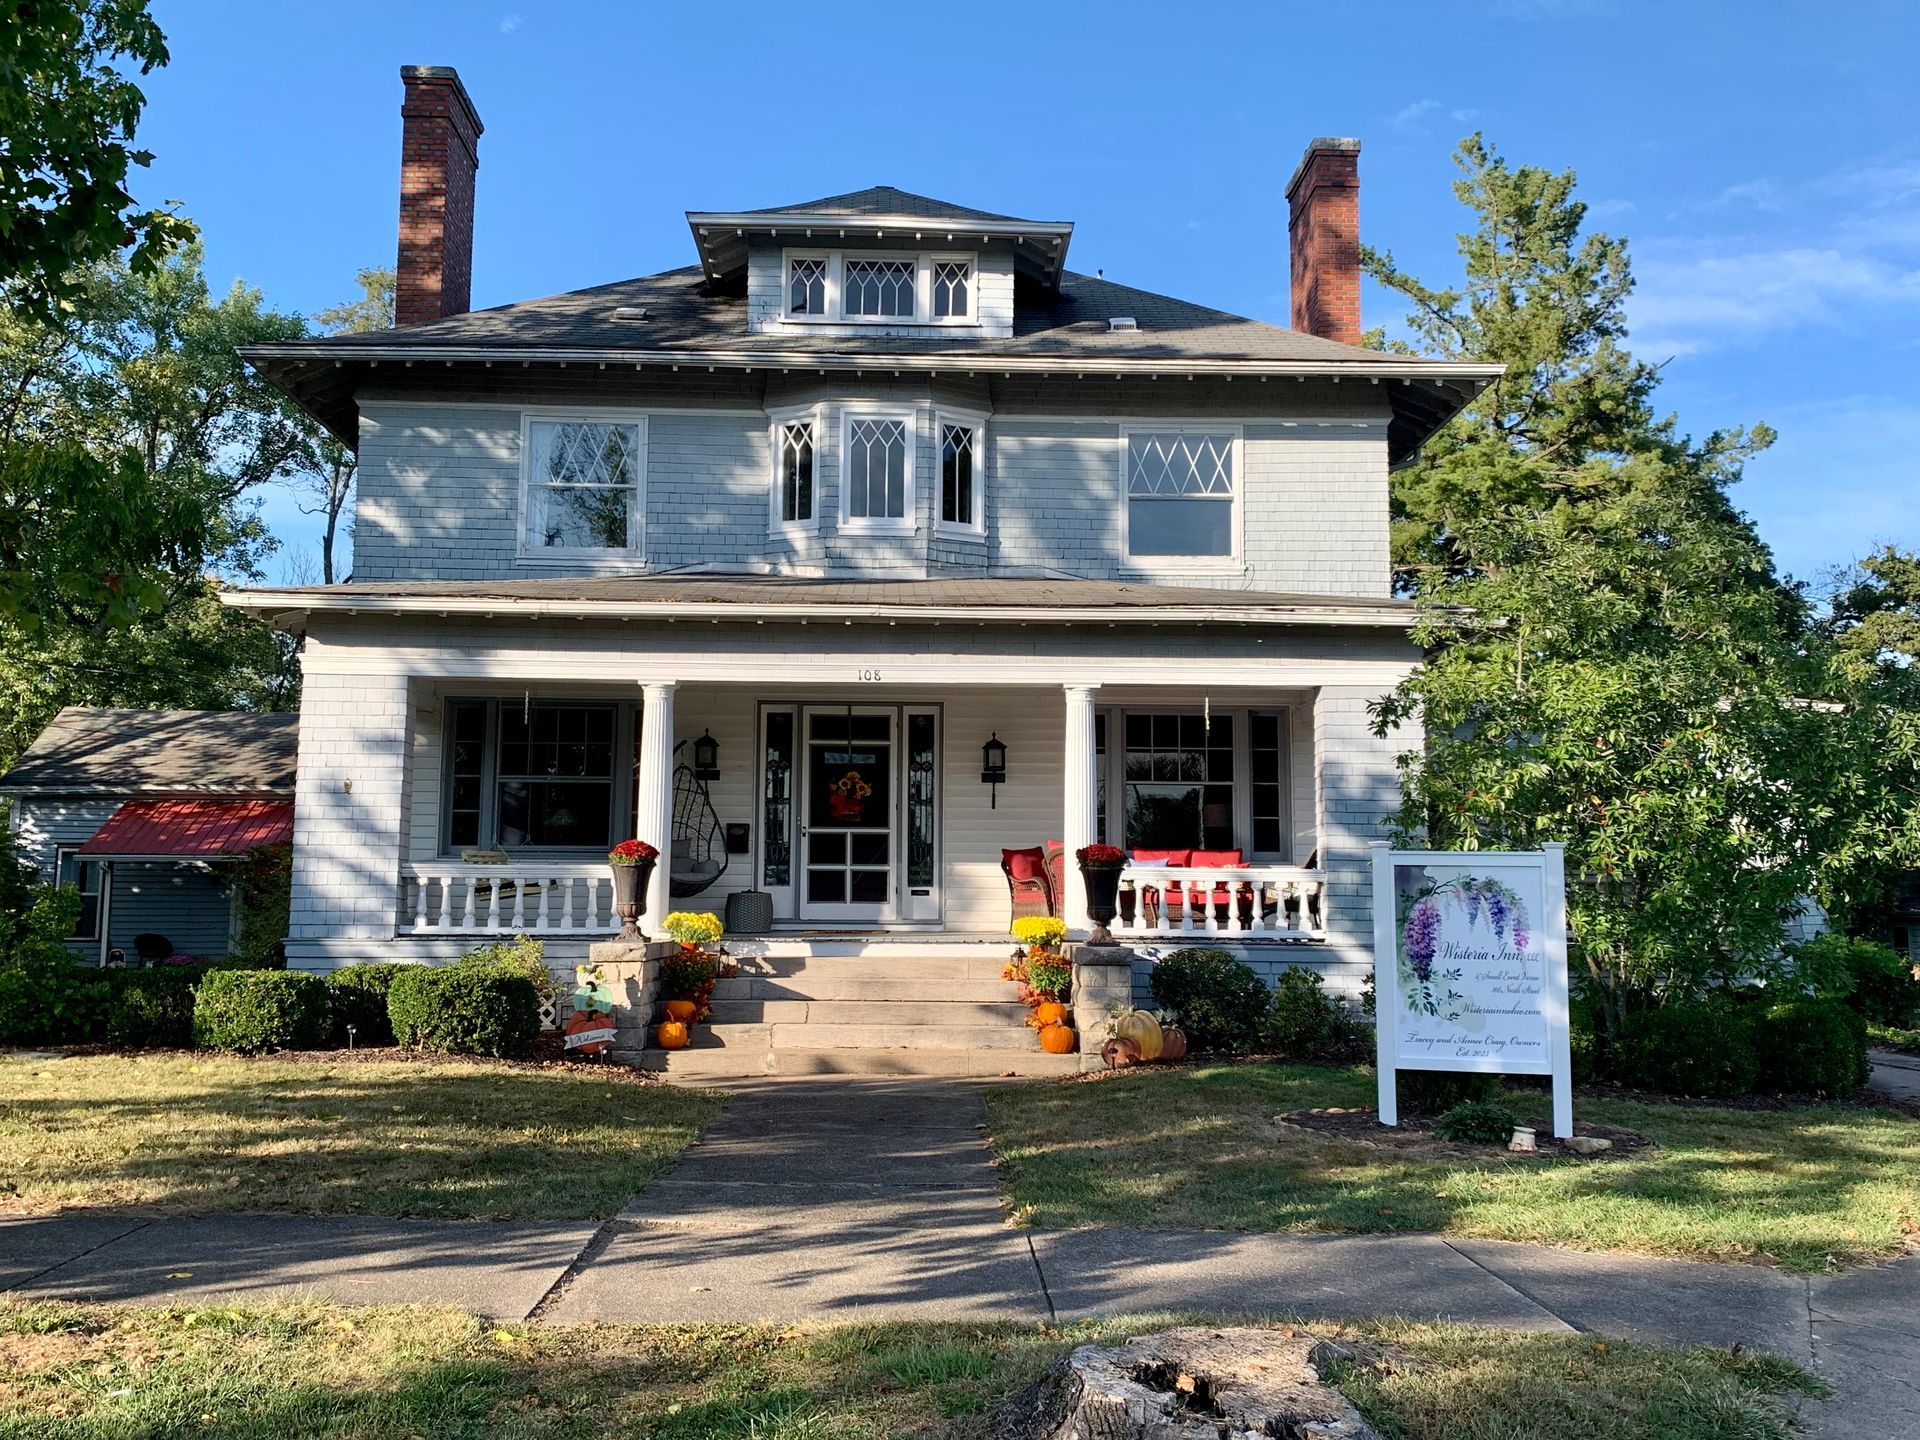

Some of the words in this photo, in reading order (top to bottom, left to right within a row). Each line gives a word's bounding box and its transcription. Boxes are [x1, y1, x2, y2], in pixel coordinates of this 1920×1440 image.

[858, 669, 882, 681] 108
[1440, 942, 1489, 961] Wisteria
[1480, 971, 1503, 980] Small
[1503, 971, 1520, 981] Event
[1500, 982, 1523, 994] North
[1522, 984, 1541, 994] Street
[1462, 1000, 1542, 1016] Wisteriainnohio.com
[574, 1034, 606, 1043] Welcome
[1404, 1030, 1435, 1051] Tracey
[1436, 1034, 1455, 1044] and
[1509, 1035, 1541, 1047] Owners
